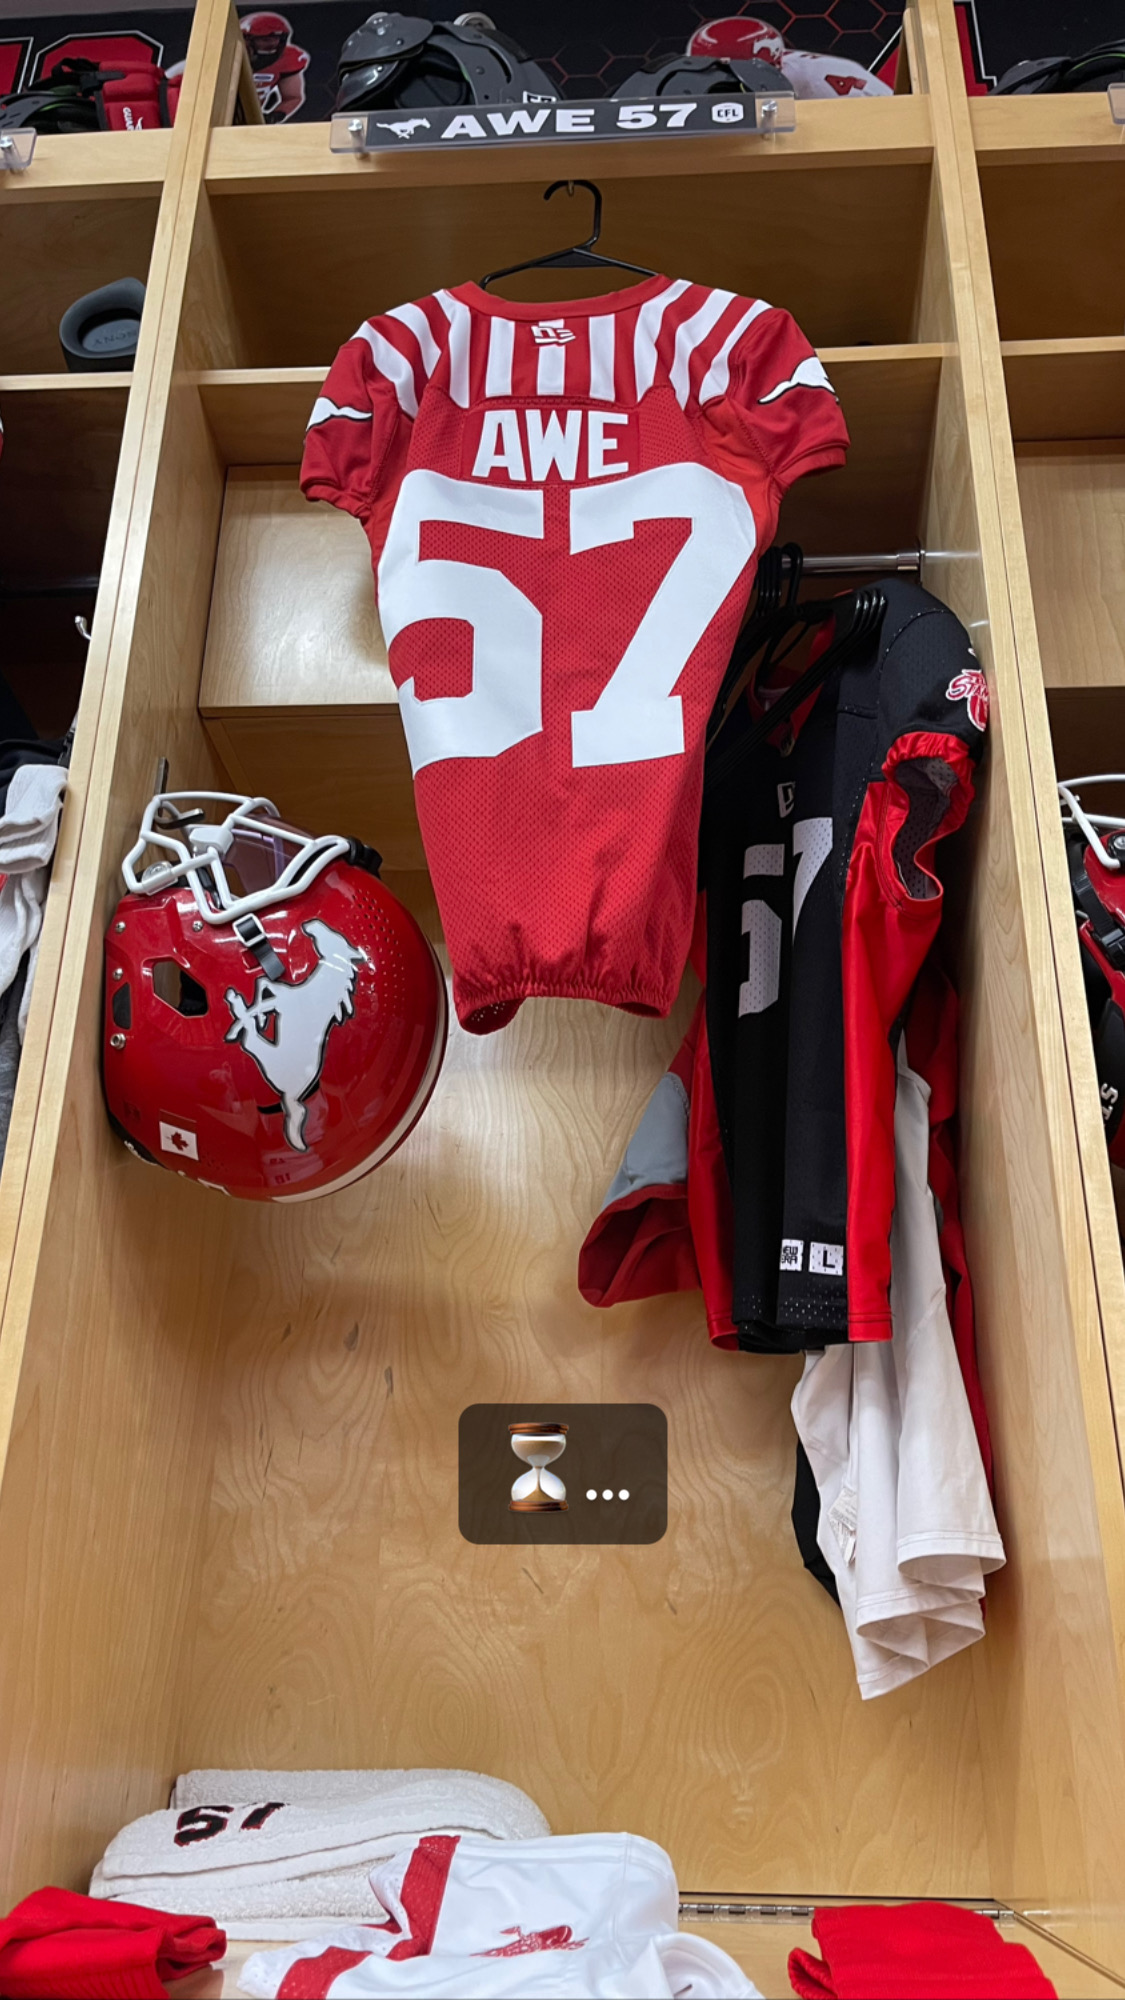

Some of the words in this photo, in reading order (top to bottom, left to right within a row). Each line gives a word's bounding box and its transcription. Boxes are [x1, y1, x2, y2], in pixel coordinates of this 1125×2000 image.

[441, 109, 595, 138] AWE
[616, 103, 697, 129] 57
[472, 408, 629, 482] AWE
[378, 461, 757, 780] 57
[822, 1249, 836, 1269] L
